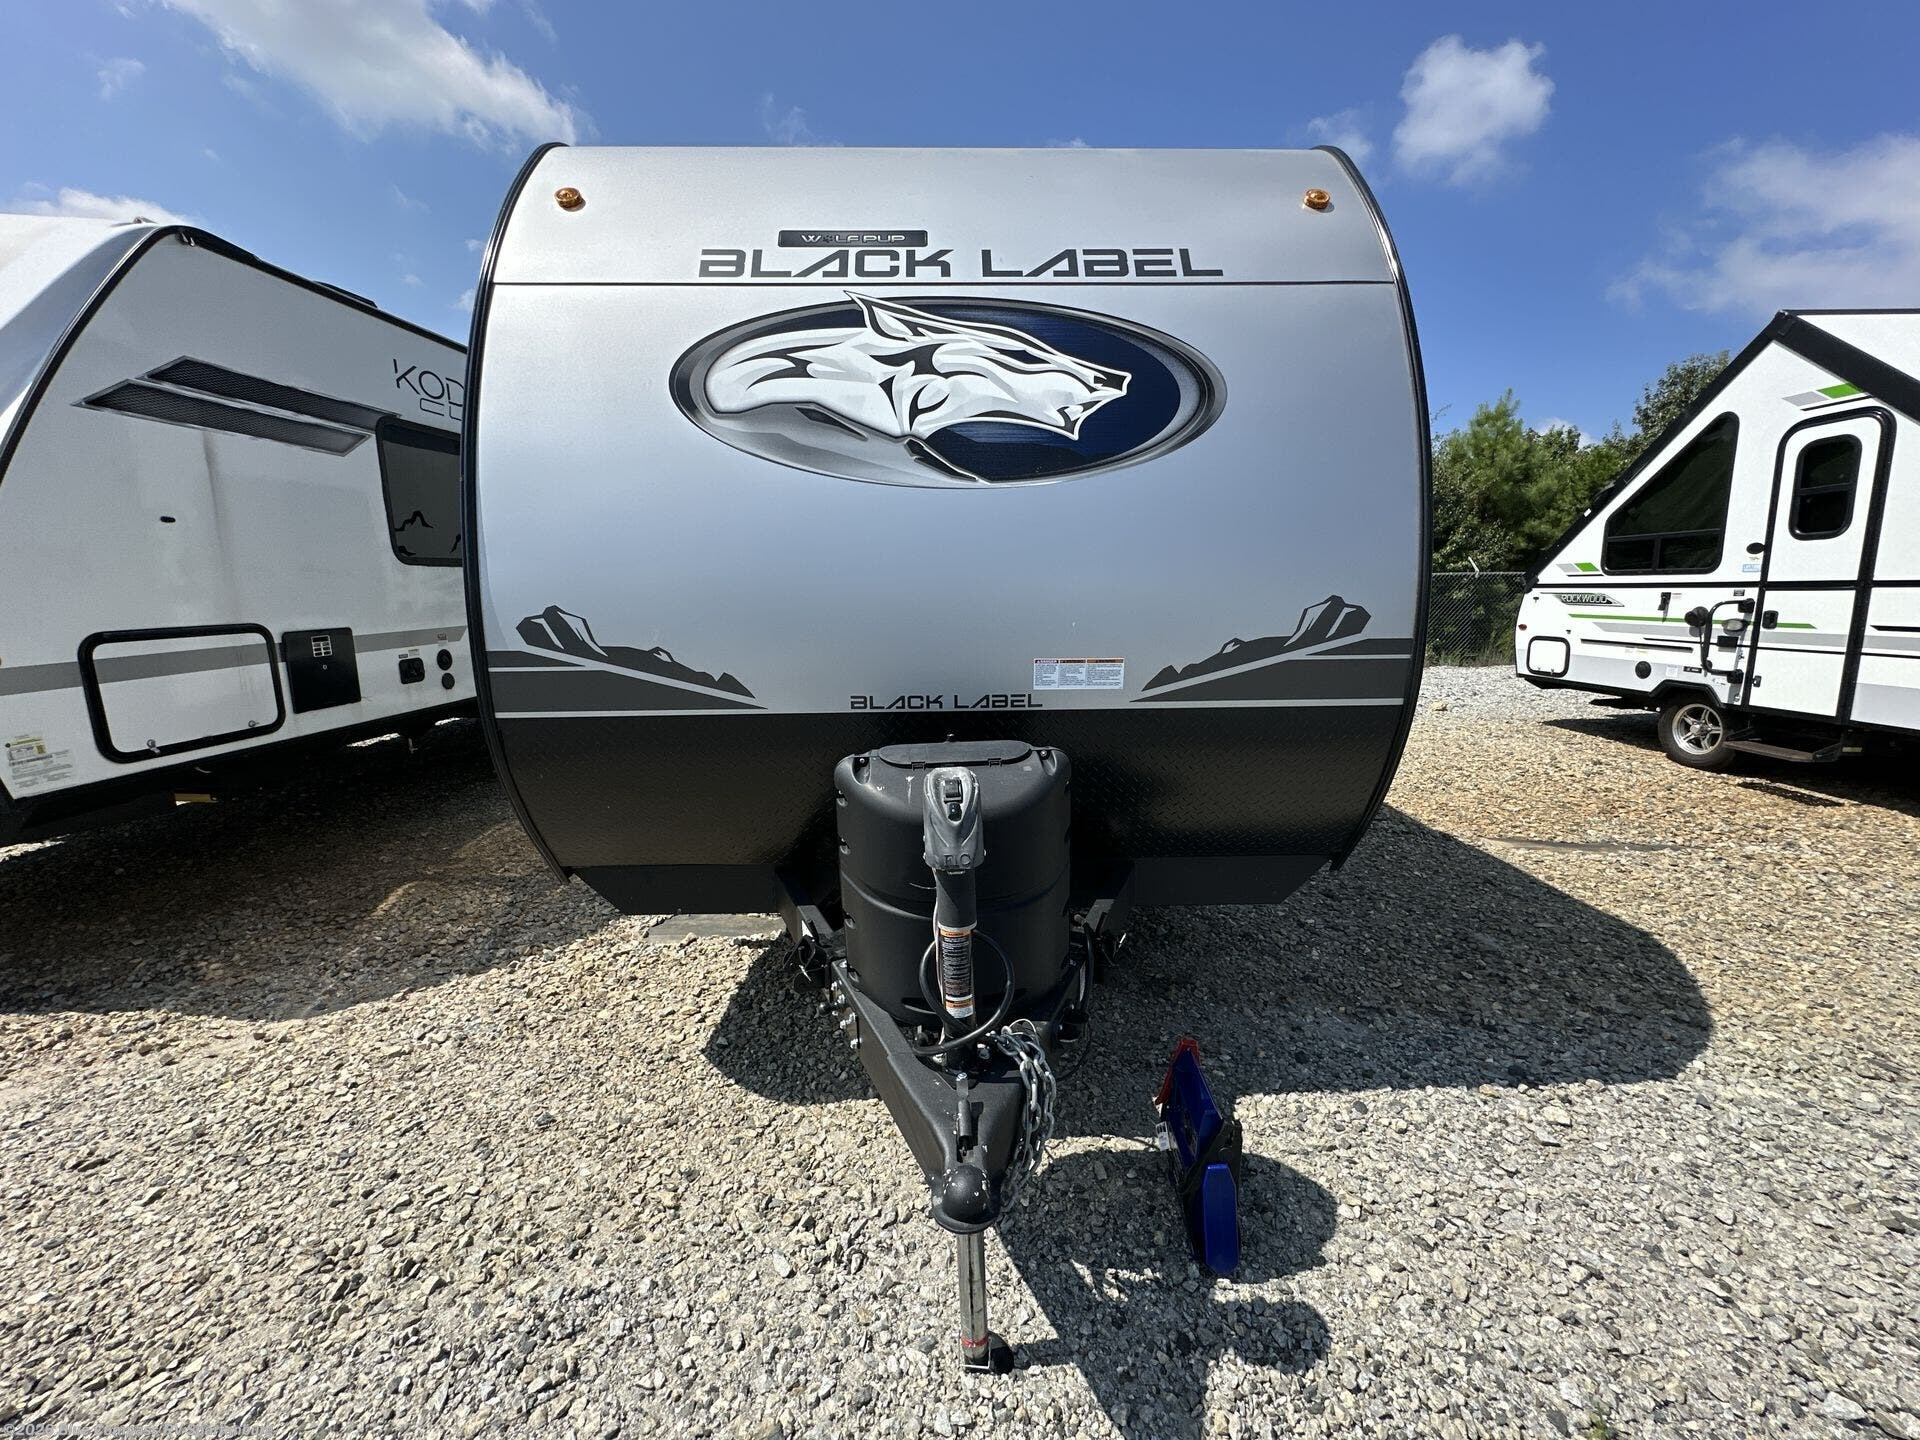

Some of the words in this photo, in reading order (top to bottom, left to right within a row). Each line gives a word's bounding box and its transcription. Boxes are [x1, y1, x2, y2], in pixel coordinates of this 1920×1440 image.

[863, 235, 906, 243] PUP
[699, 248, 954, 277] BLACK
[982, 248, 1224, 277] LABEL
[1561, 593, 1608, 604] ROCKWOOD
[850, 695, 943, 709] BLACK
[954, 694, 1043, 708] LABEL
